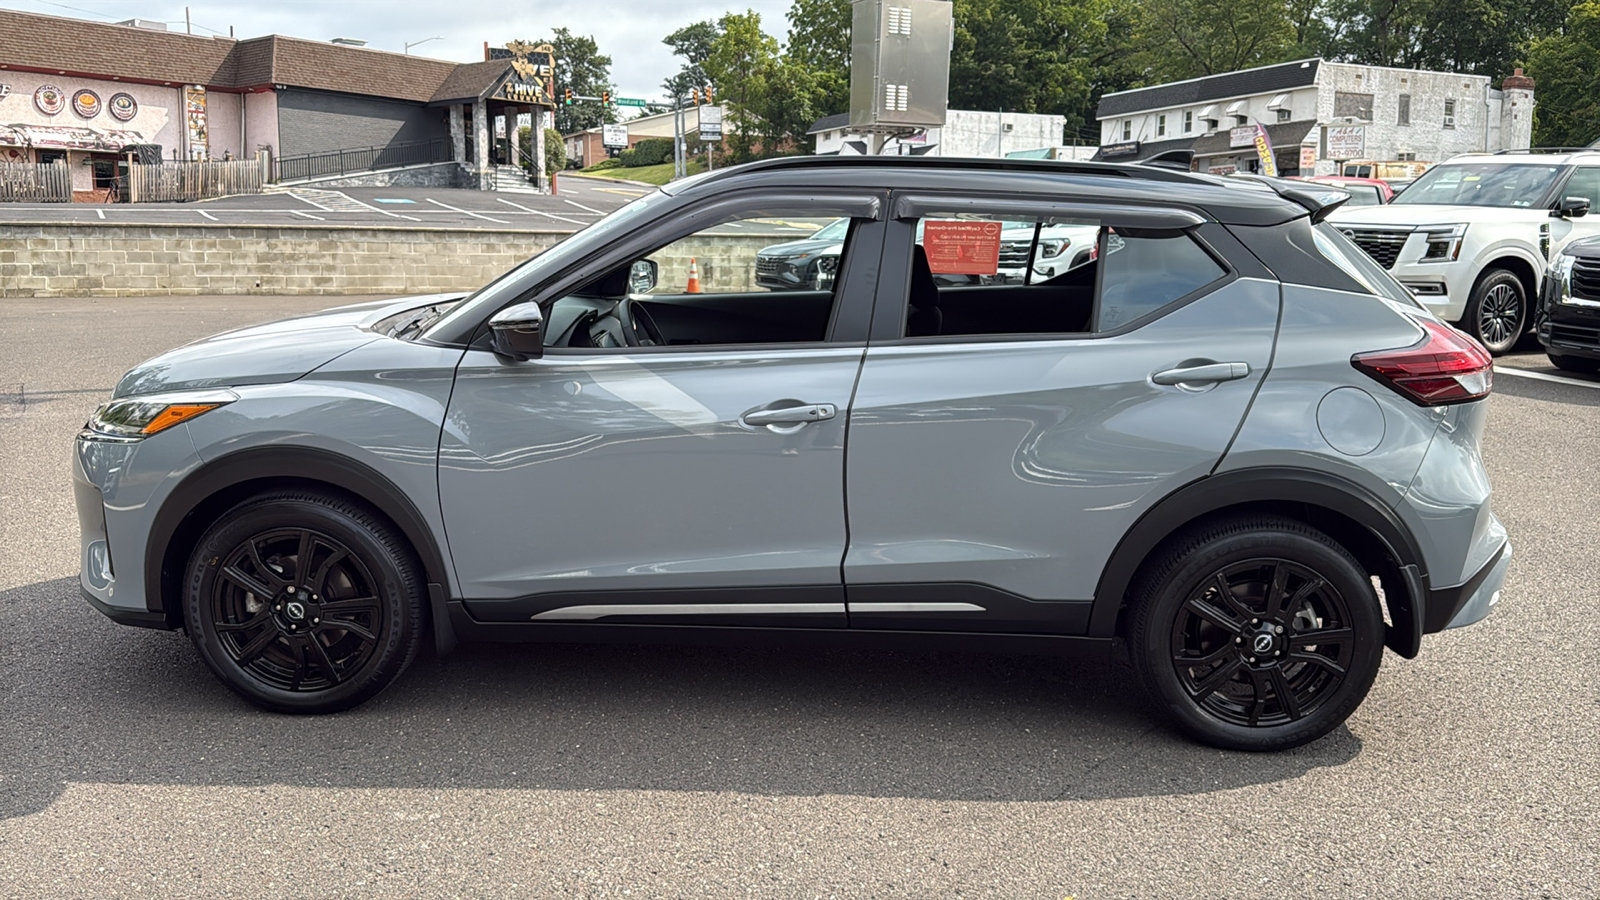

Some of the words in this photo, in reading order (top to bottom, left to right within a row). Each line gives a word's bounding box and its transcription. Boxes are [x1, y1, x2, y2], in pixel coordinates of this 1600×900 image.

[515, 83, 543, 97] HIVE
[508, 93, 542, 103] LOUNGE
[1327, 149, 1363, 157] 942-9700
